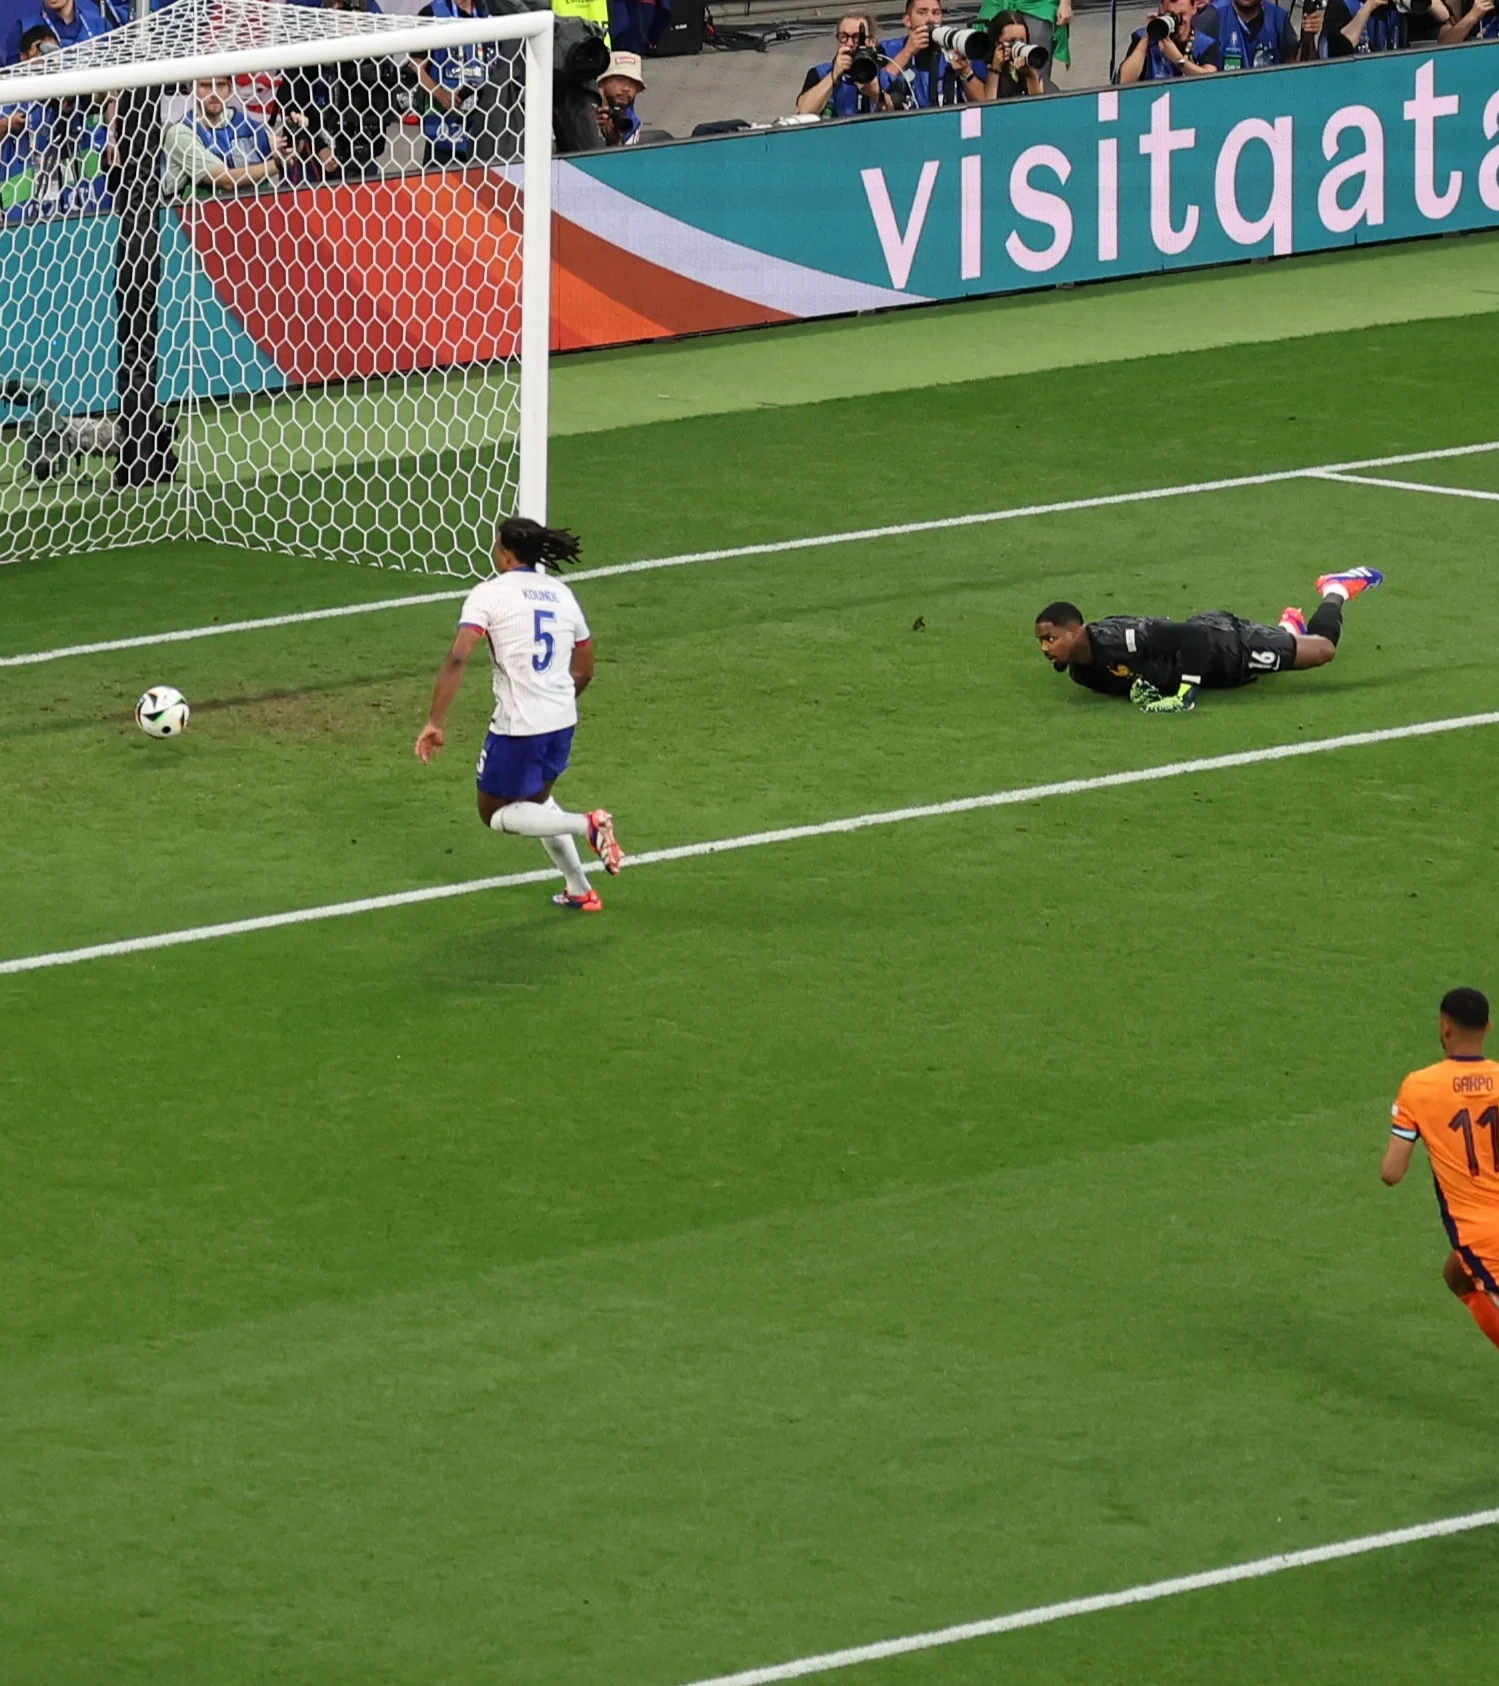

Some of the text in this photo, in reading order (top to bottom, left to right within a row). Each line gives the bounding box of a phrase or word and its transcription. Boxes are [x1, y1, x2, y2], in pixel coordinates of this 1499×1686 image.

[532, 609, 555, 673] 5
[1248, 650, 1276, 669] 16
[1452, 1075, 1494, 1093] GAKPO
